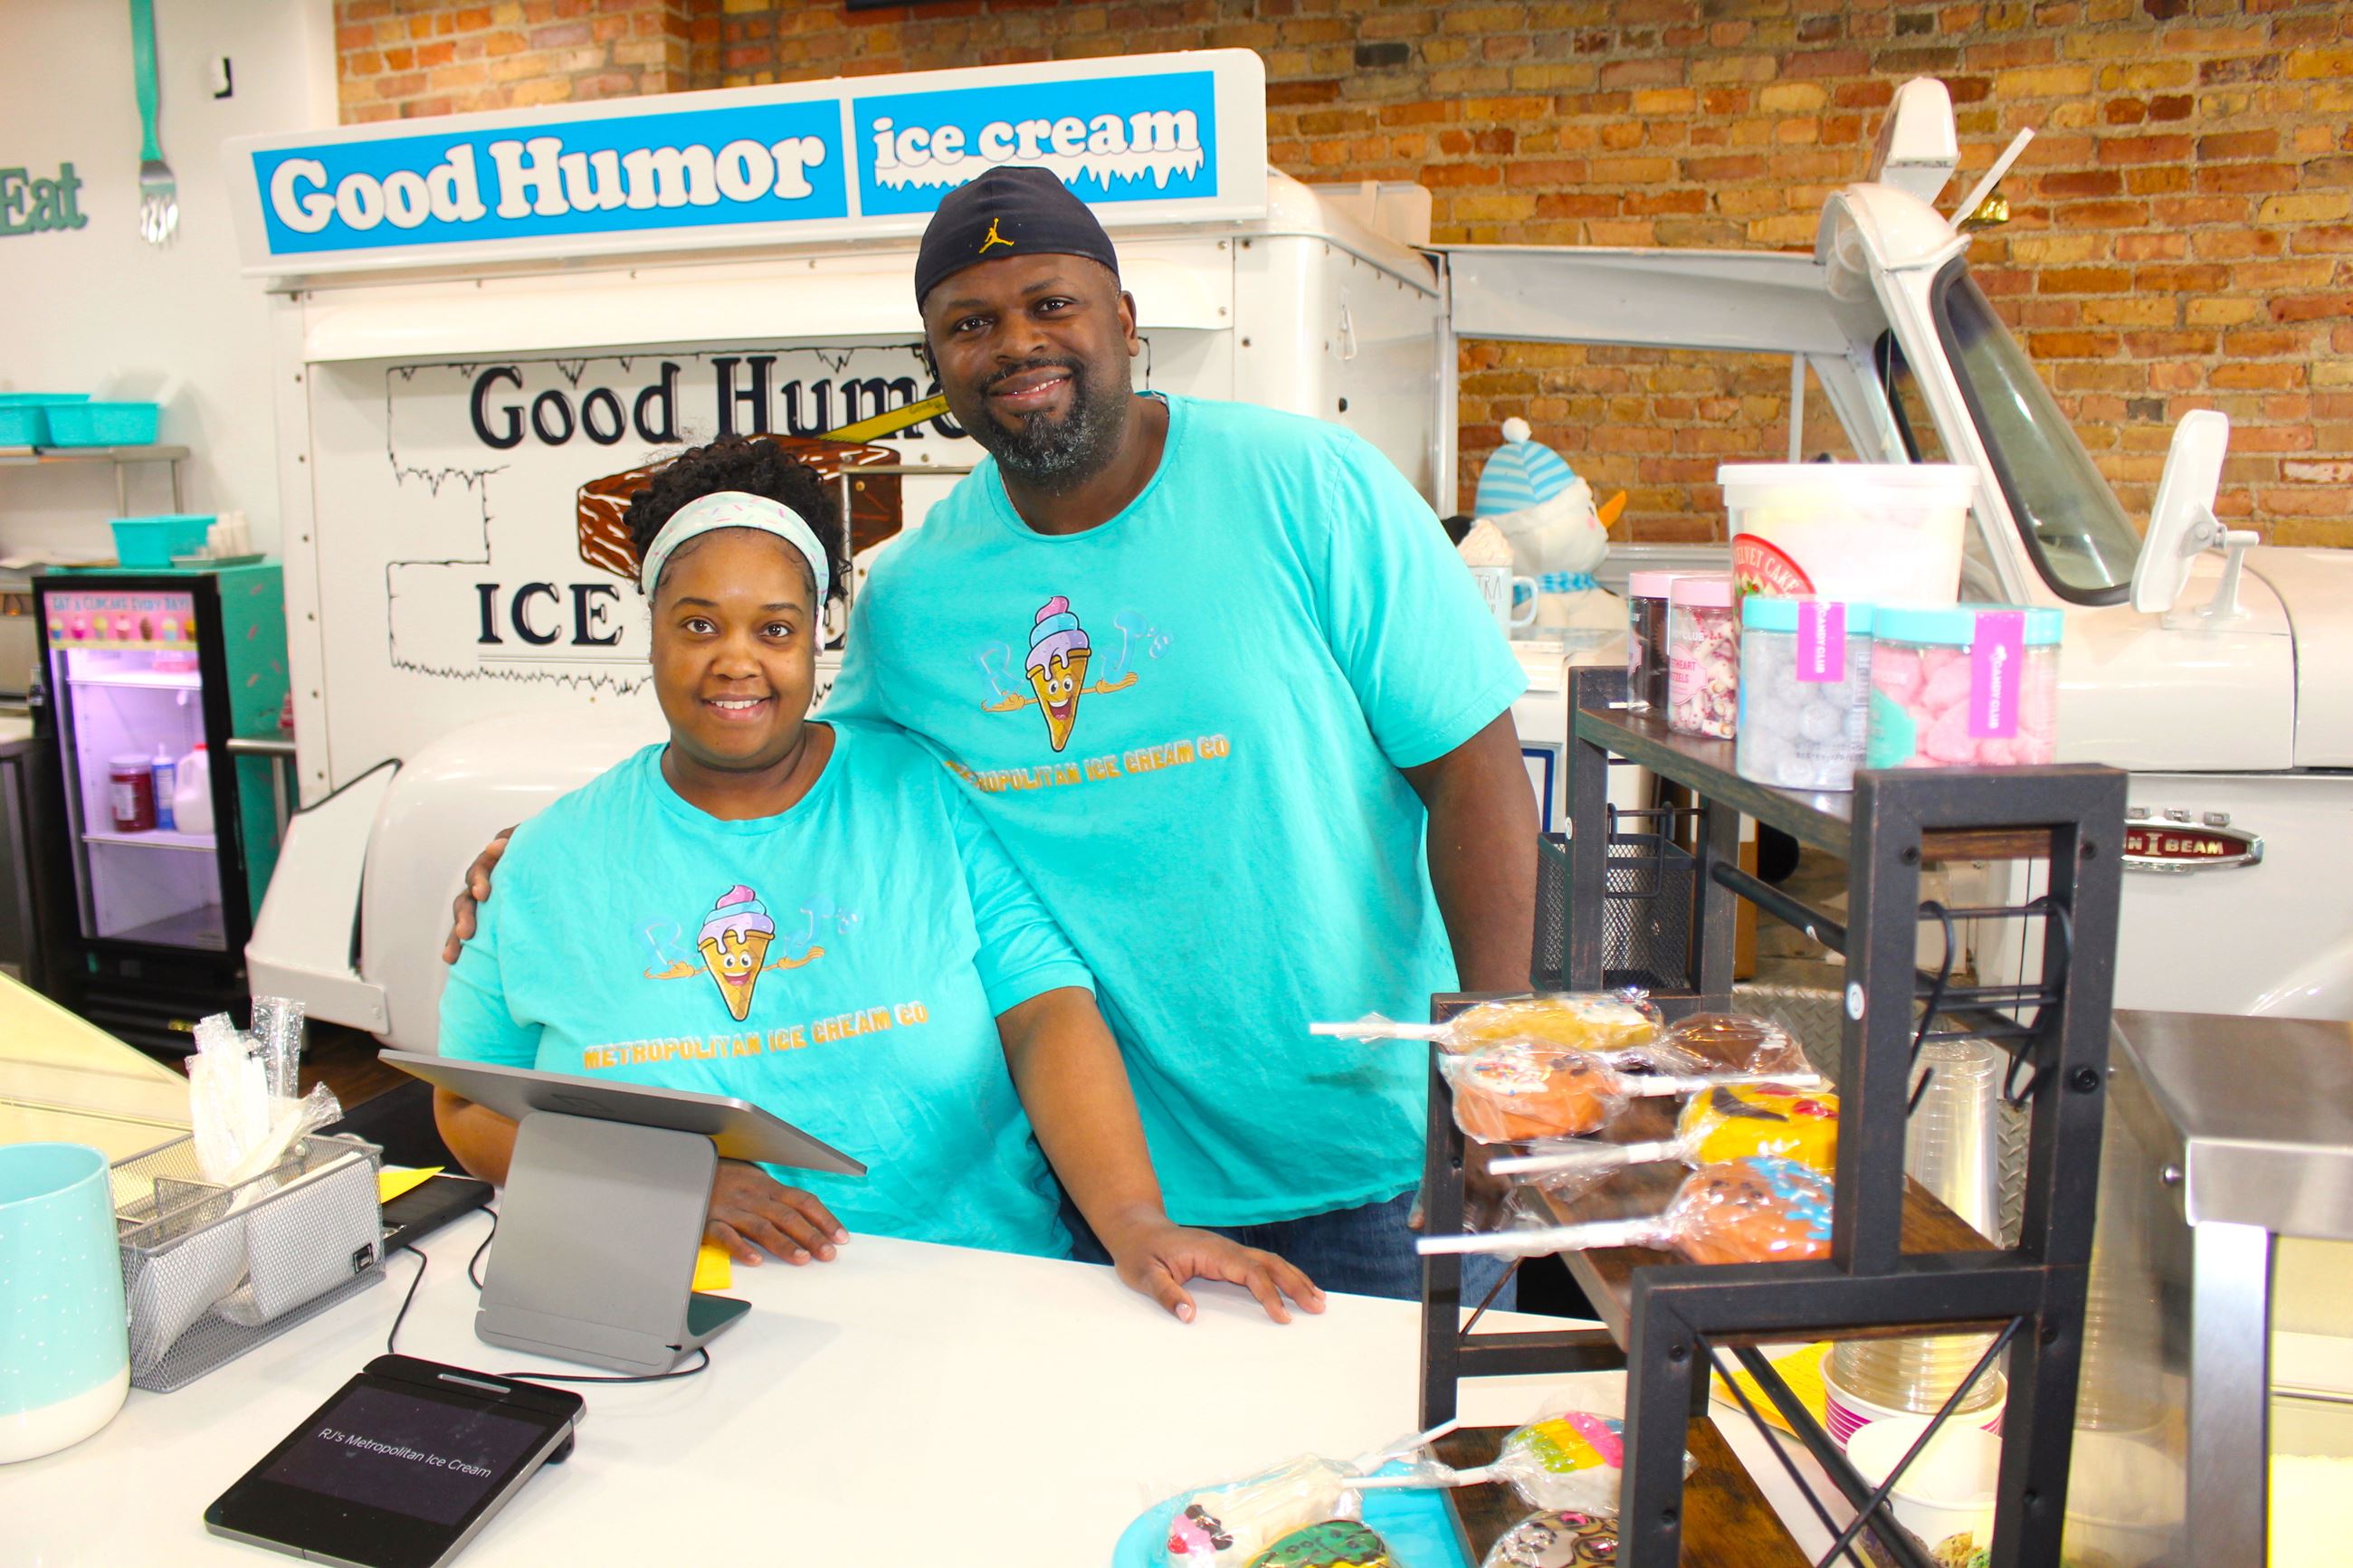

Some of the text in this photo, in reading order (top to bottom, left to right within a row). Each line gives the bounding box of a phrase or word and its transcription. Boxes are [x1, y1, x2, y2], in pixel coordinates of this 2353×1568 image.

[872, 109, 1201, 169] ice cream
[0, 162, 89, 236] Eat
[270, 136, 826, 233] Good Humor
[470, 361, 682, 449] Good
[1765, 557, 1800, 593] CAKE
[475, 582, 624, 647] ICE
[1815, 611, 1827, 674] CANDY CLUB
[1988, 699, 2002, 729] CLUB
[1083, 755, 1122, 783] ICE
[1122, 738, 1196, 774] CREAM
[1196, 733, 1230, 760] CO
[2128, 806, 2231, 827] ORD
[2165, 839, 2224, 855] BEAM
[583, 1000, 929, 1071] METROPOLITAN ICE CREAM CO
[318, 1428, 492, 1478] RJ's Metropolitan Ice Cream
